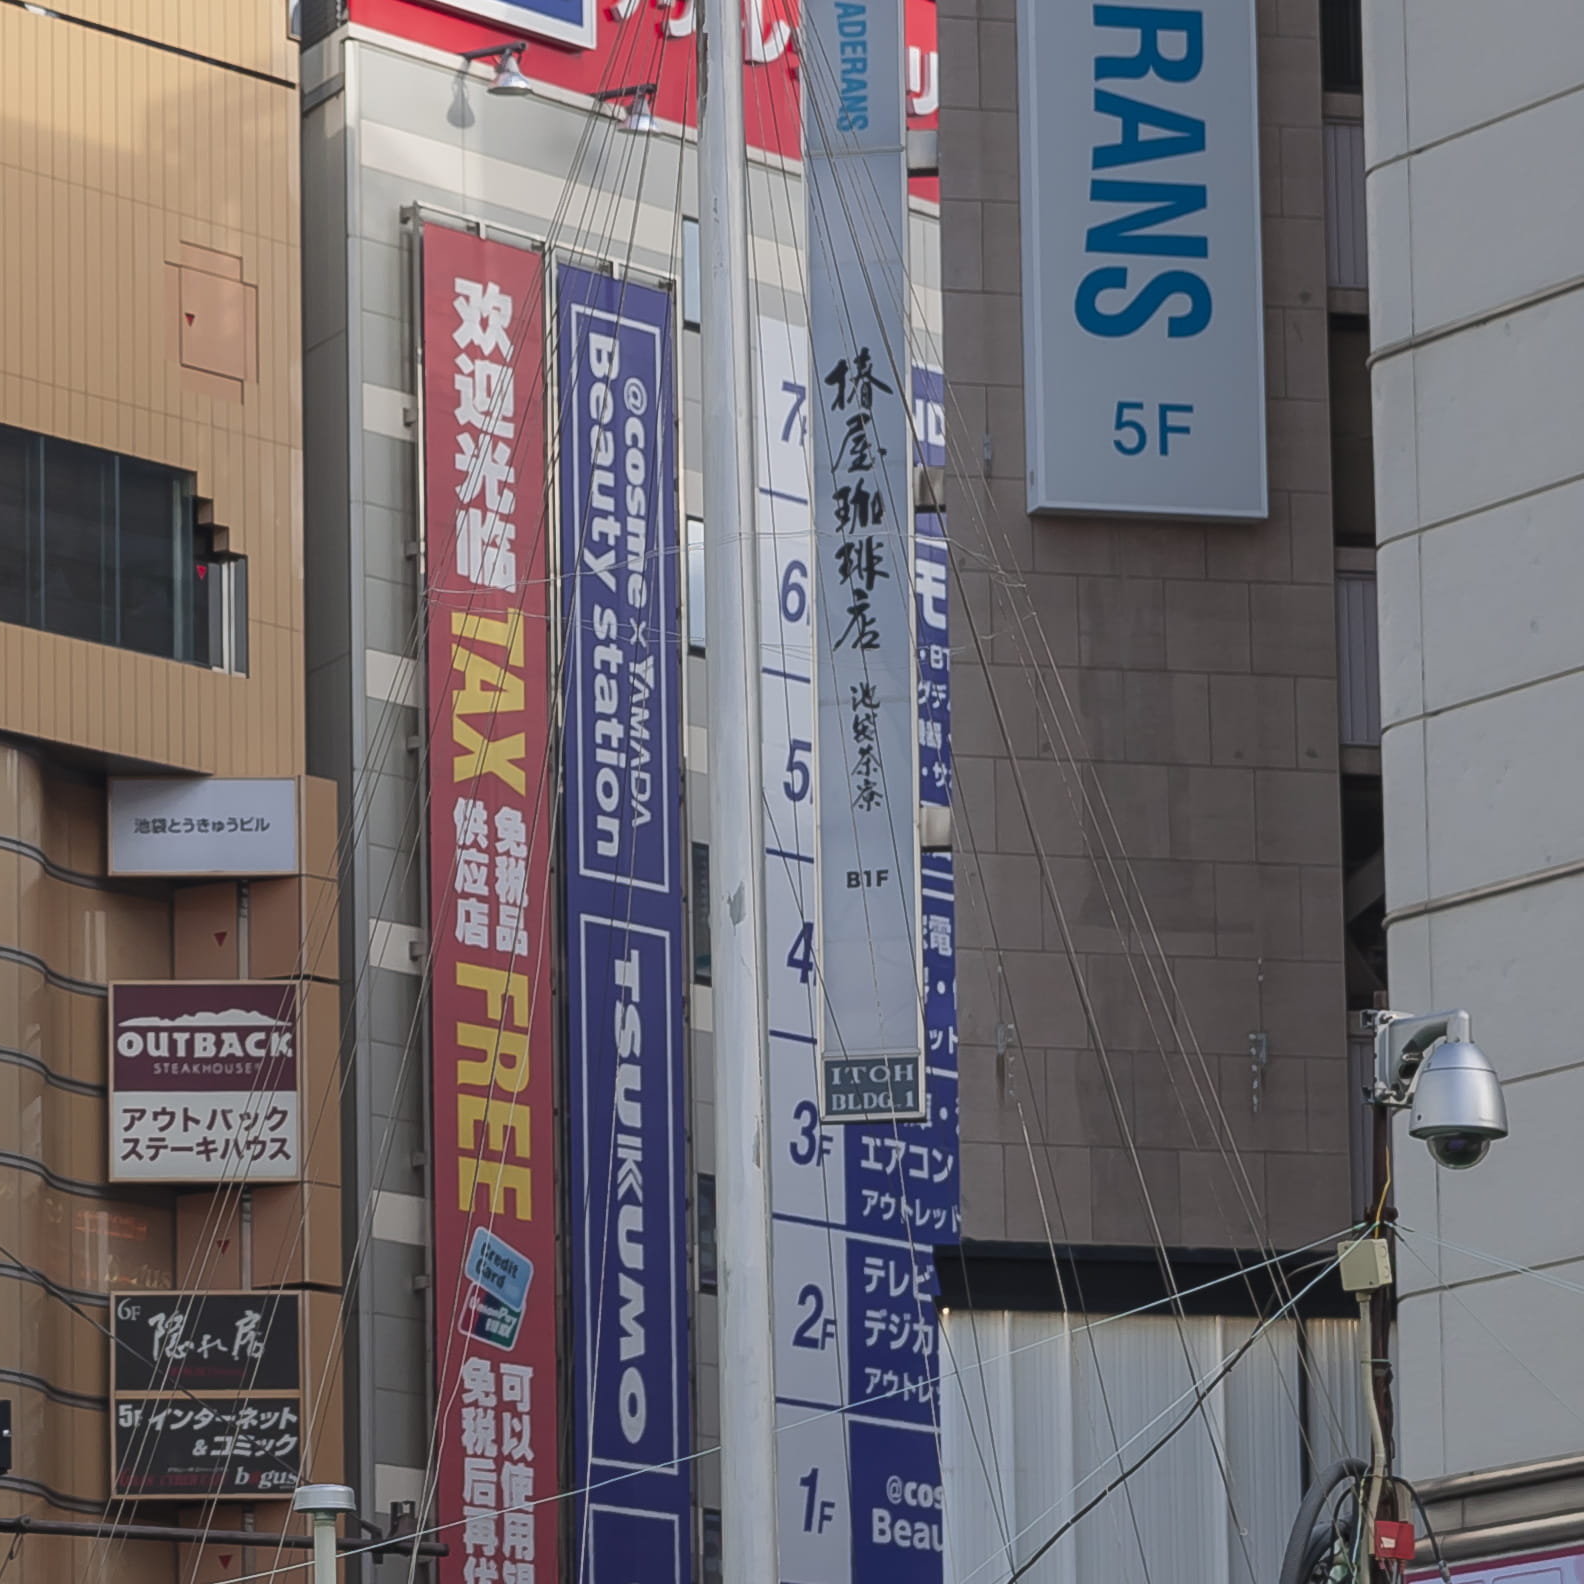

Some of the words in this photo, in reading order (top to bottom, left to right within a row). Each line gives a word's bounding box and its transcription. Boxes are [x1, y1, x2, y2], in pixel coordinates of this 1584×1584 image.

[833, 0, 870, 134] ADERANS
[451, 276, 517, 594] 欢迎光临
[582, 331, 622, 593] Beauty
[1111, 399, 1195, 458] 5F
[622, 376, 649, 610] @cosme
[451, 608, 527, 797] TAX
[592, 603, 628, 859] station
[628, 654, 656, 828] YAMADA
[133, 816, 271, 835] 池袋とうきゅうビル
[452, 797, 489, 949] 供应店
[493, 804, 529, 958] 免税品
[846, 869, 889, 889] B1F
[117, 1031, 294, 1058] OUTBACK
[153, 1062, 254, 1075] STEAKHOUSE
[831, 1063, 914, 1086] ITOH
[121, 1106, 289, 1133] アウトバック
[455, 961, 533, 1222] FREE
[120, 1135, 292, 1162] ステーキハウス
[788, 1099, 834, 1168] 3F
[860, 1135, 954, 1184] エアコン
[612, 949, 647, 1445] TSUKUMO
[117, 1297, 142, 1321] 6F
[863, 1256, 935, 1303] テレビ
[791, 1283, 838, 1351] 2F
[864, 1307, 940, 1356] デジカ
[149, 1406, 298, 1430] インターネット
[799, 1466, 836, 1535] 1F
